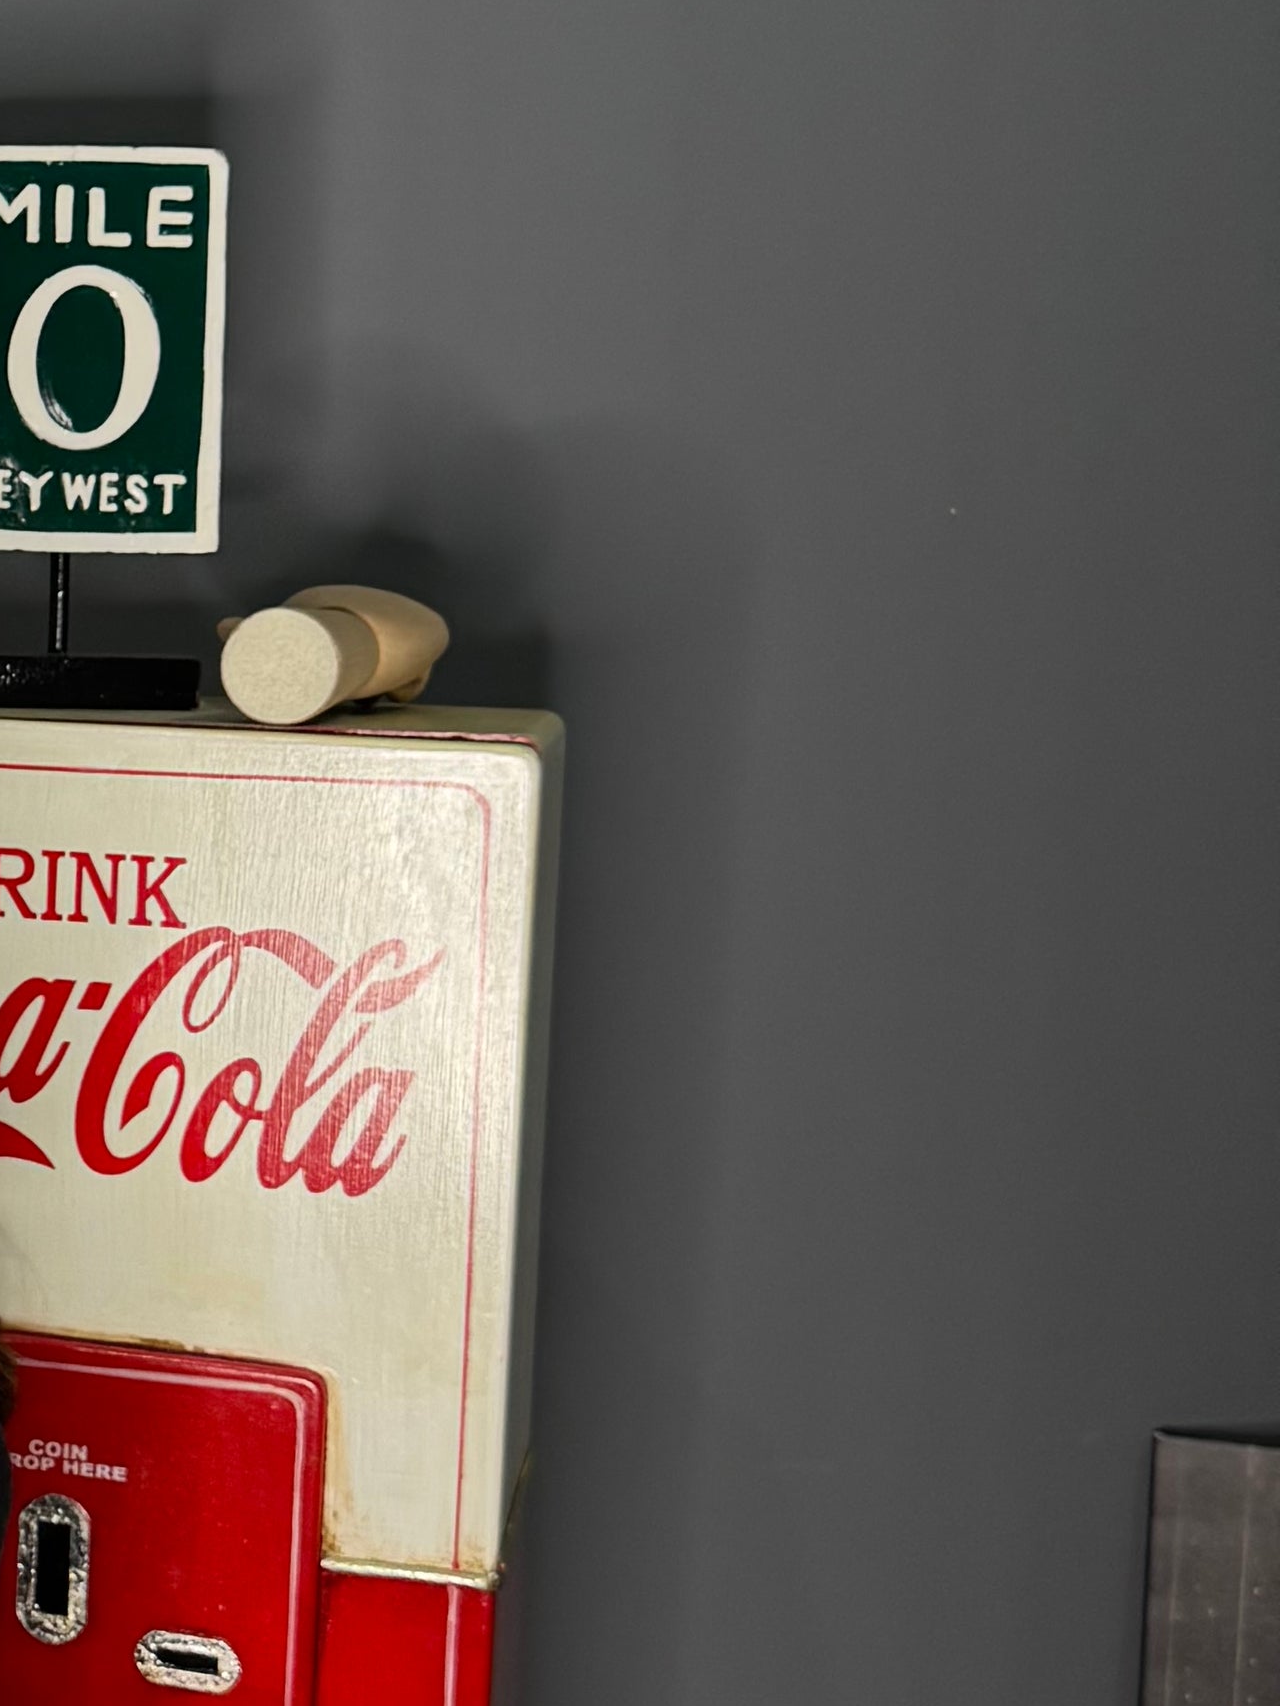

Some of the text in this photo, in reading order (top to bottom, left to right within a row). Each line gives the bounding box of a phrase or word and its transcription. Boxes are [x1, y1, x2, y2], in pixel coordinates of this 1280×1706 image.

[62, 471, 188, 515] WEST
[28, 1438, 89, 1461] COIN
[9, 1452, 129, 1483] ROP HERE
